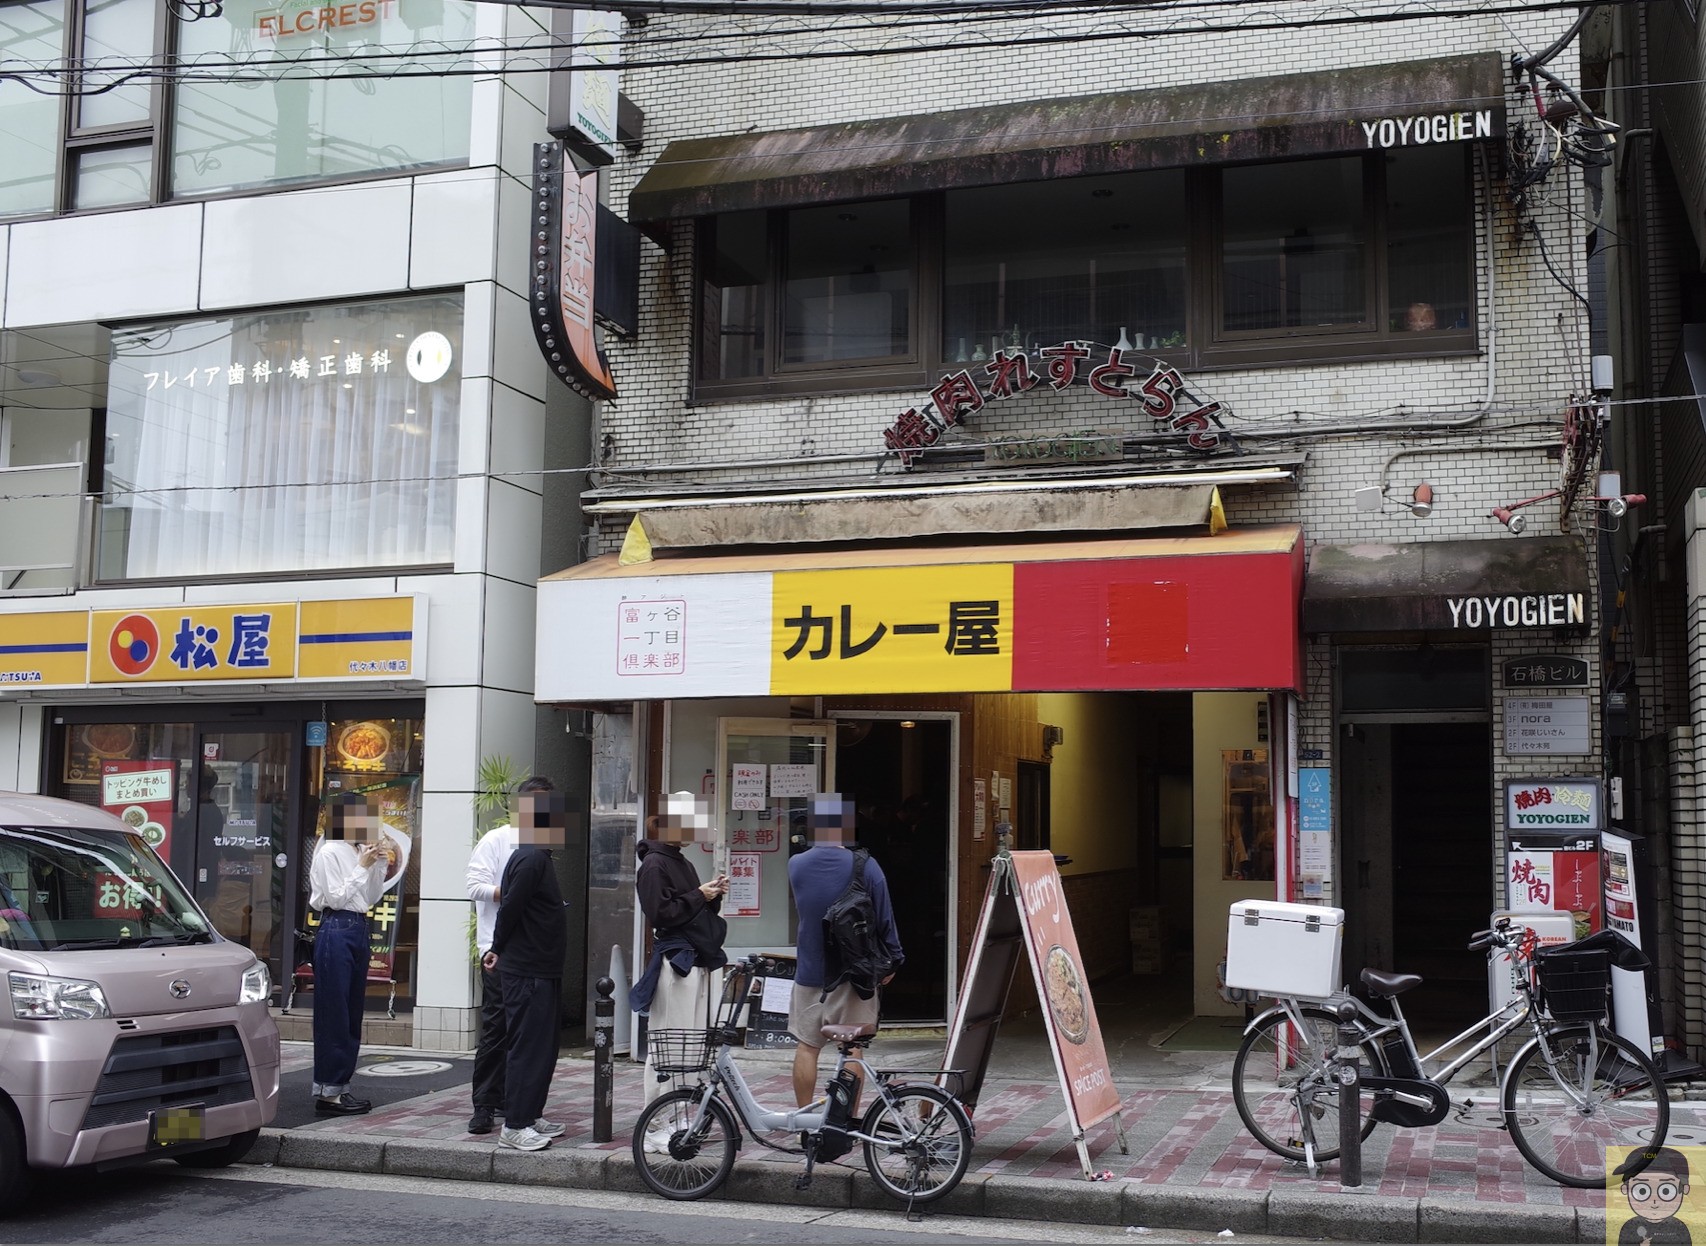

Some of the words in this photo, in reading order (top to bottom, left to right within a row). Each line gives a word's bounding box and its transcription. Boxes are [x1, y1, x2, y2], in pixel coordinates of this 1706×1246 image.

[258, 0, 395, 38] ELCREST
[1361, 109, 1492, 149] YOYOGIEN
[143, 348, 392, 391] フレイア歯科・矯正歯科
[883, 340, 1222, 467] 焼肉れすとらん
[1447, 593, 1584, 628] YOYOGIEN
[170, 614, 271, 670] 松屋
[623, 630, 679, 645] 一丁目
[783, 600, 1000, 661] カレー屋
[349, 660, 407, 671] 代々木八幡店
[1511, 665, 1582, 682] 石橋ビル
[1521, 715, 1552, 723] nora
[116, 787, 157, 800] まとめ買い
[1516, 813, 1591, 824] YOYOGIEN
[213, 836, 271, 847] セルフサービス
[731, 828, 774, 845] 楽部
[731, 866, 755, 877] 募集
[1510, 858, 1551, 905] 焼肉
[1024, 870, 1060, 923] Curry
